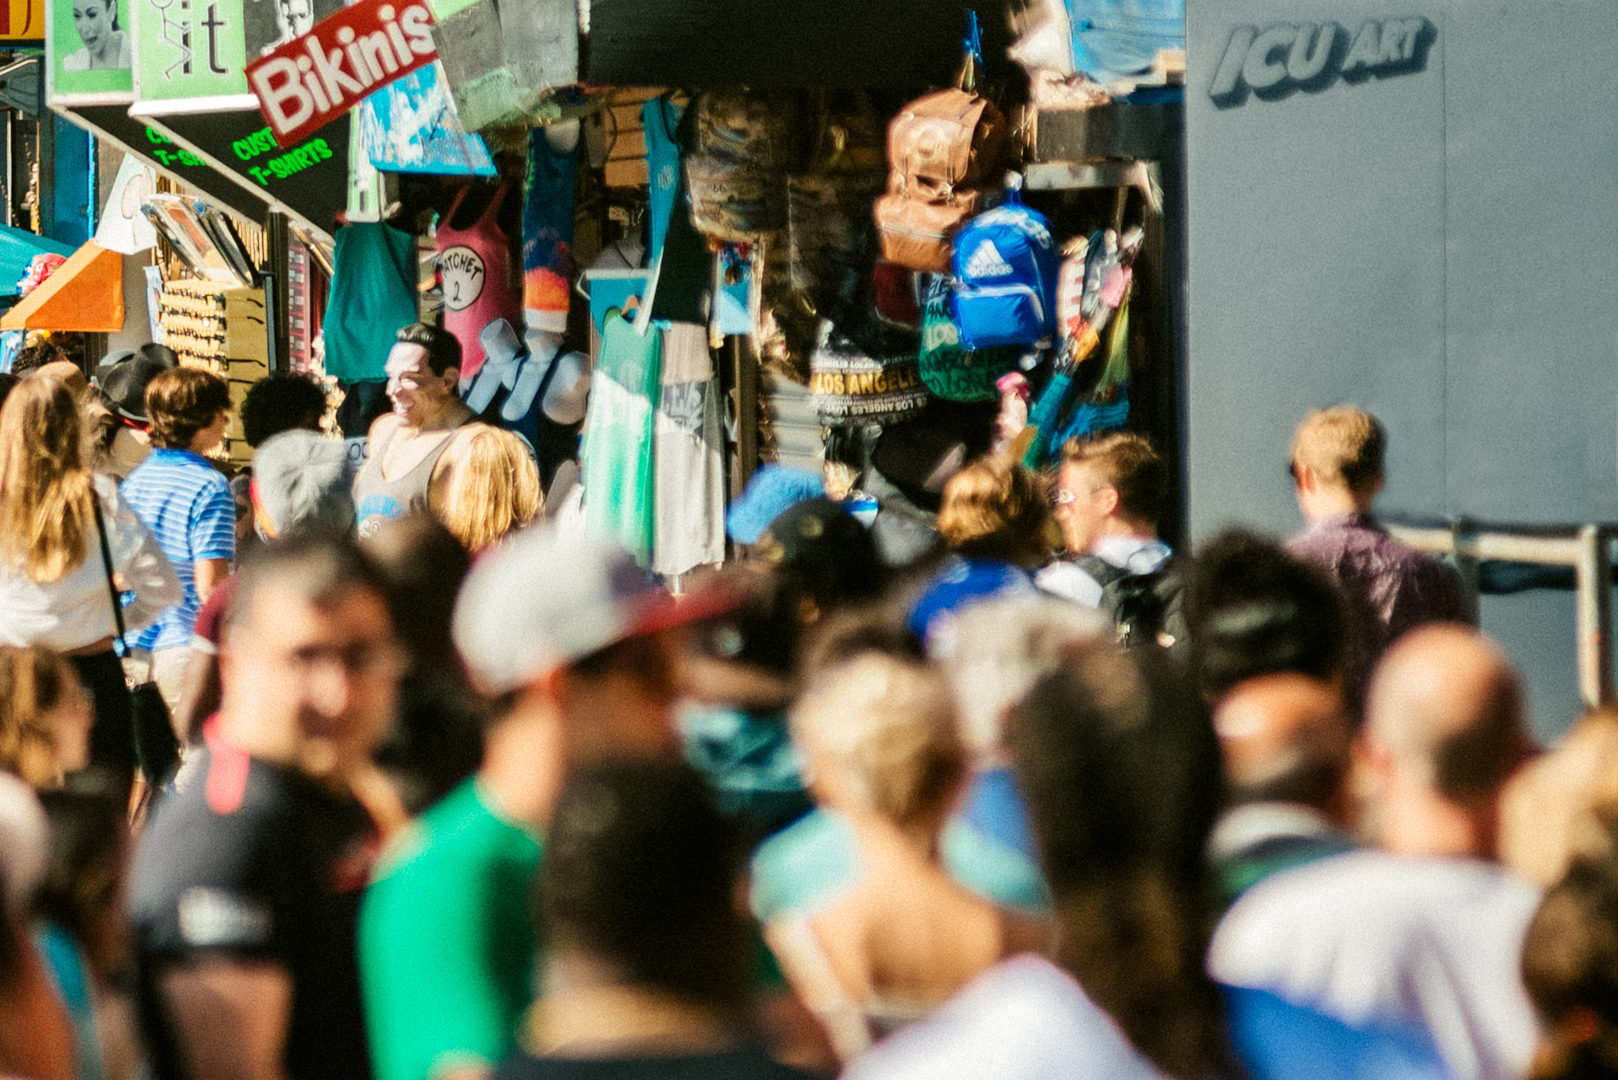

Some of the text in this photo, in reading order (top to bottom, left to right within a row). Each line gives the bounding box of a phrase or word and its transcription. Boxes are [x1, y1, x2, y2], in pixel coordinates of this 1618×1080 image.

[253, 4, 436, 135] Bikinis
[1209, 15, 1437, 110] ICU ART
[248, 138, 333, 186] T-SHIRTS
[443, 252, 483, 281] ATCHET
[969, 263, 1014, 279] adidas
[813, 372, 845, 395] LOS
